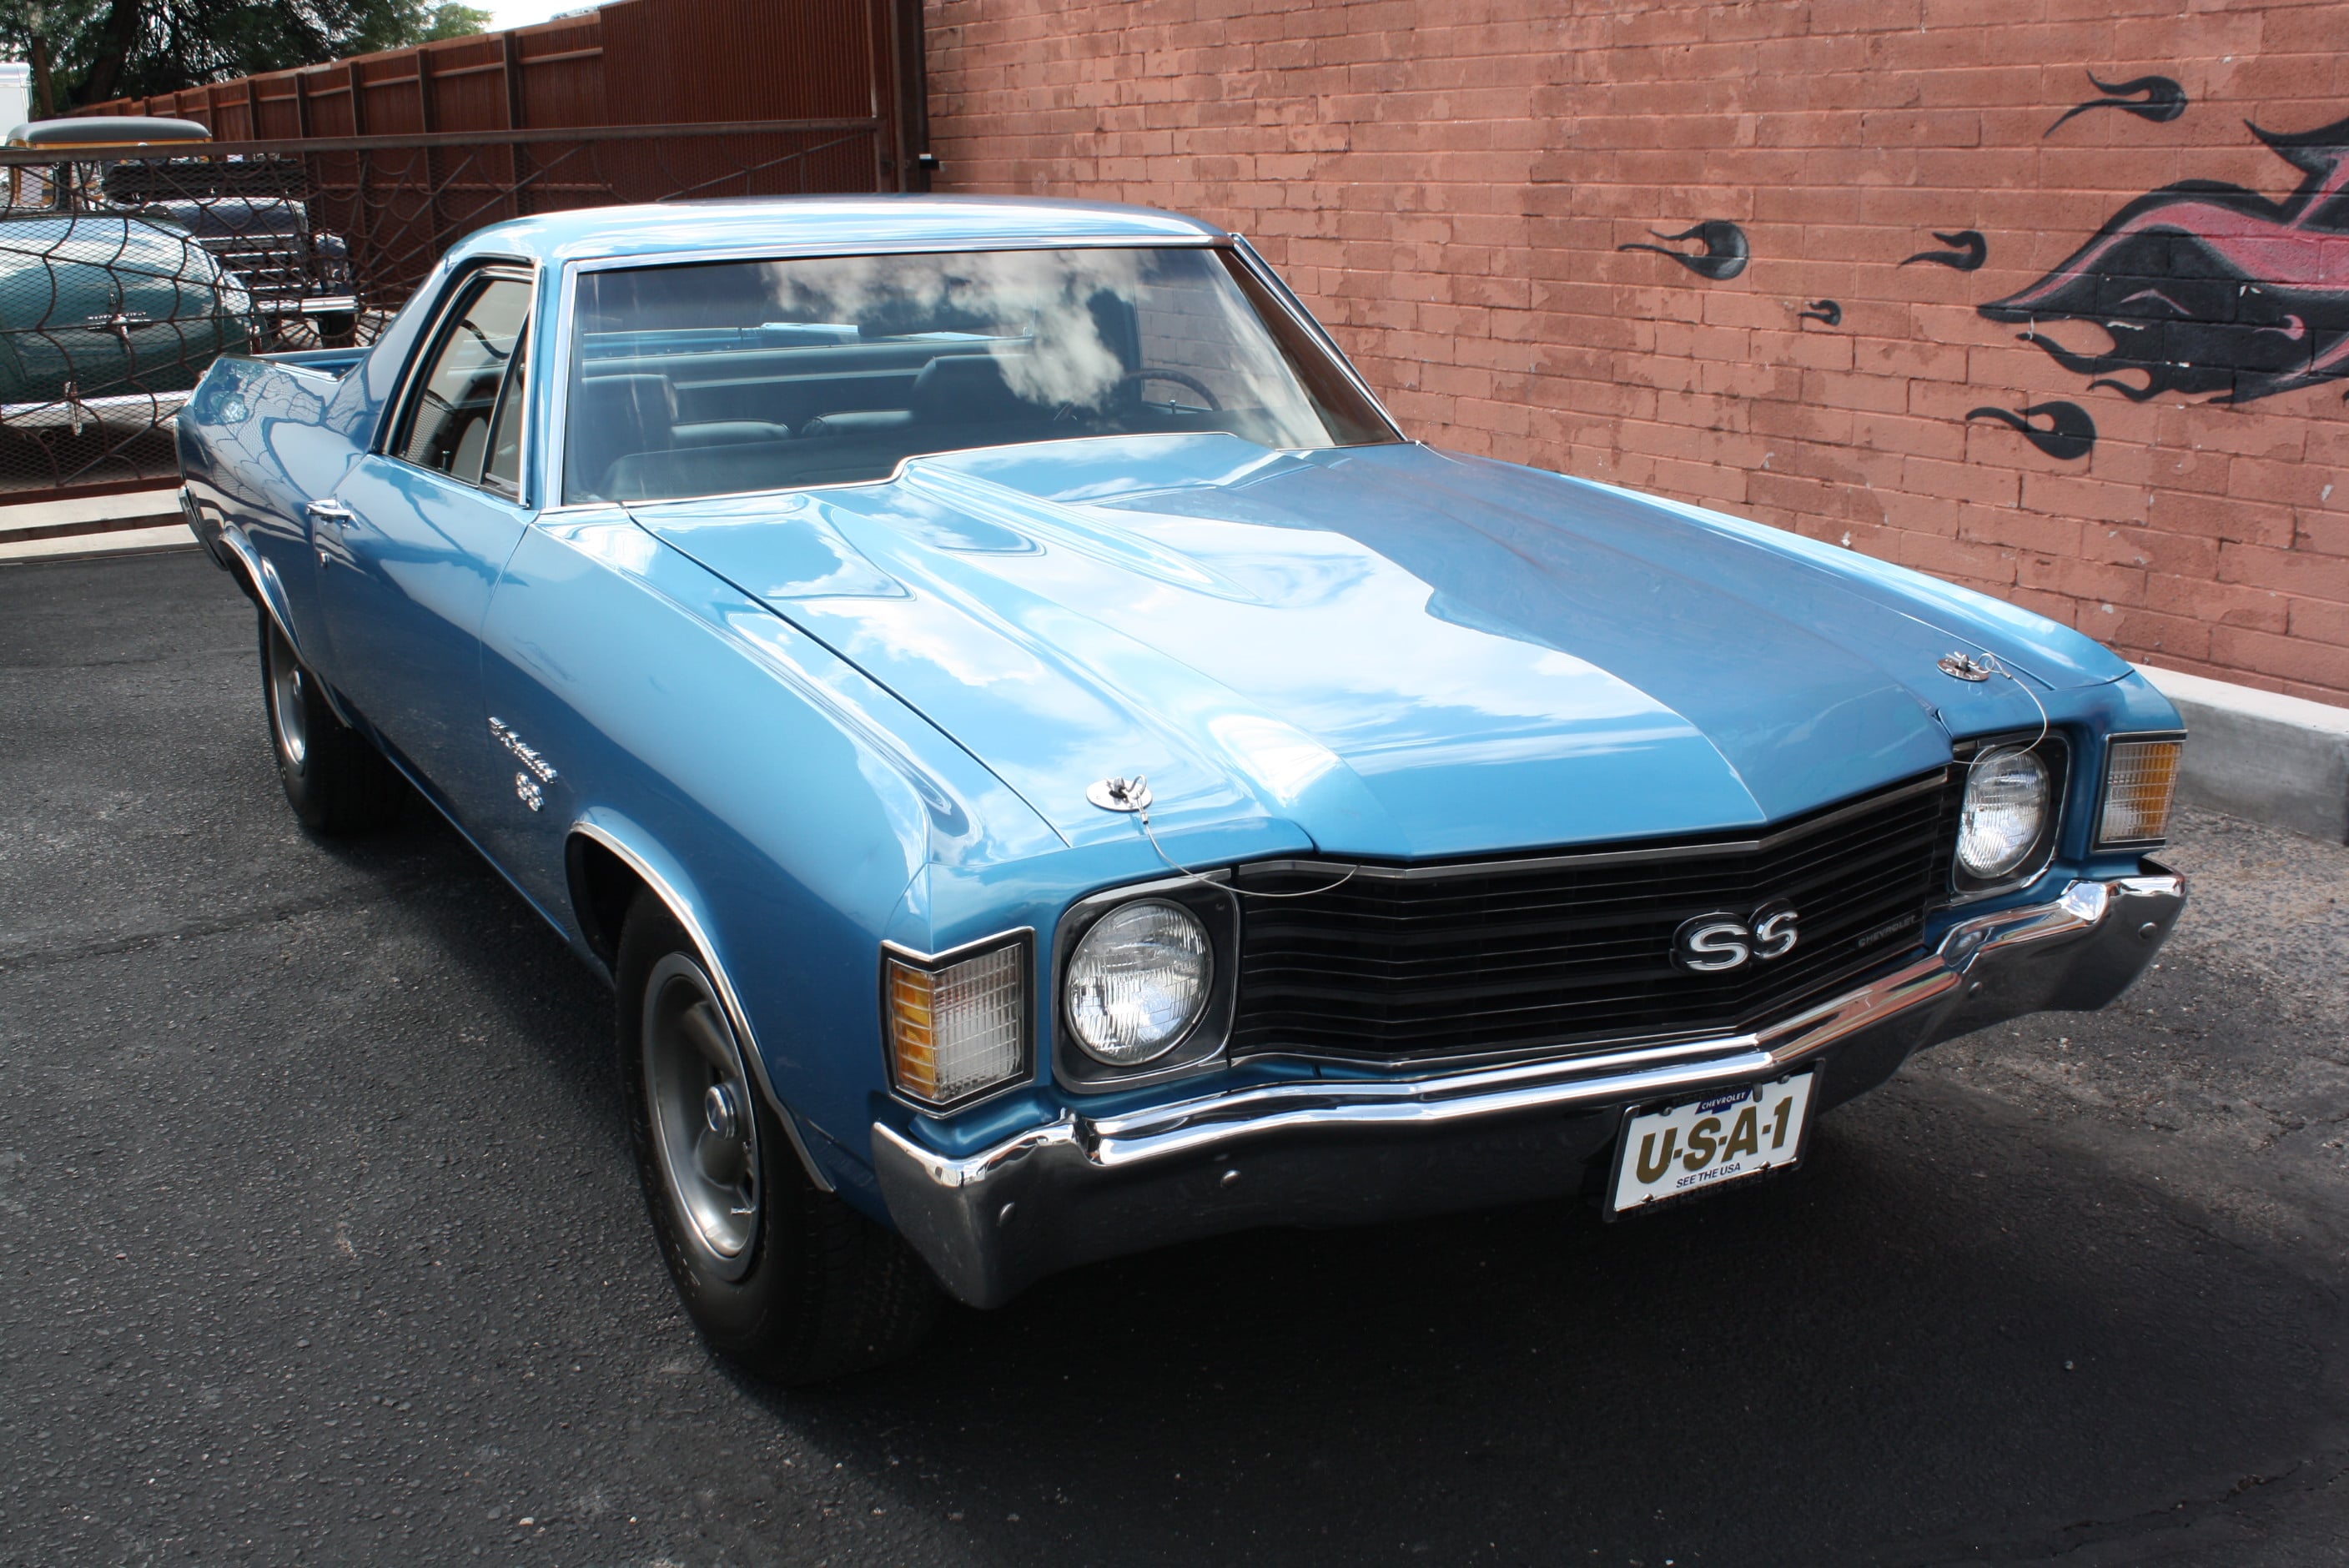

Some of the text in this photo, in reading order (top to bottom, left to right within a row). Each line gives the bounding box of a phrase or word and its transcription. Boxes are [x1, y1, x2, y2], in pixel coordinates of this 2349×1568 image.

[1682, 907, 1799, 972] SS
[1857, 914, 1917, 948] CHEVROLET
[1701, 1091, 1748, 1110] CHEVROLET
[1676, 1162, 1741, 1189] SEE THE USA
